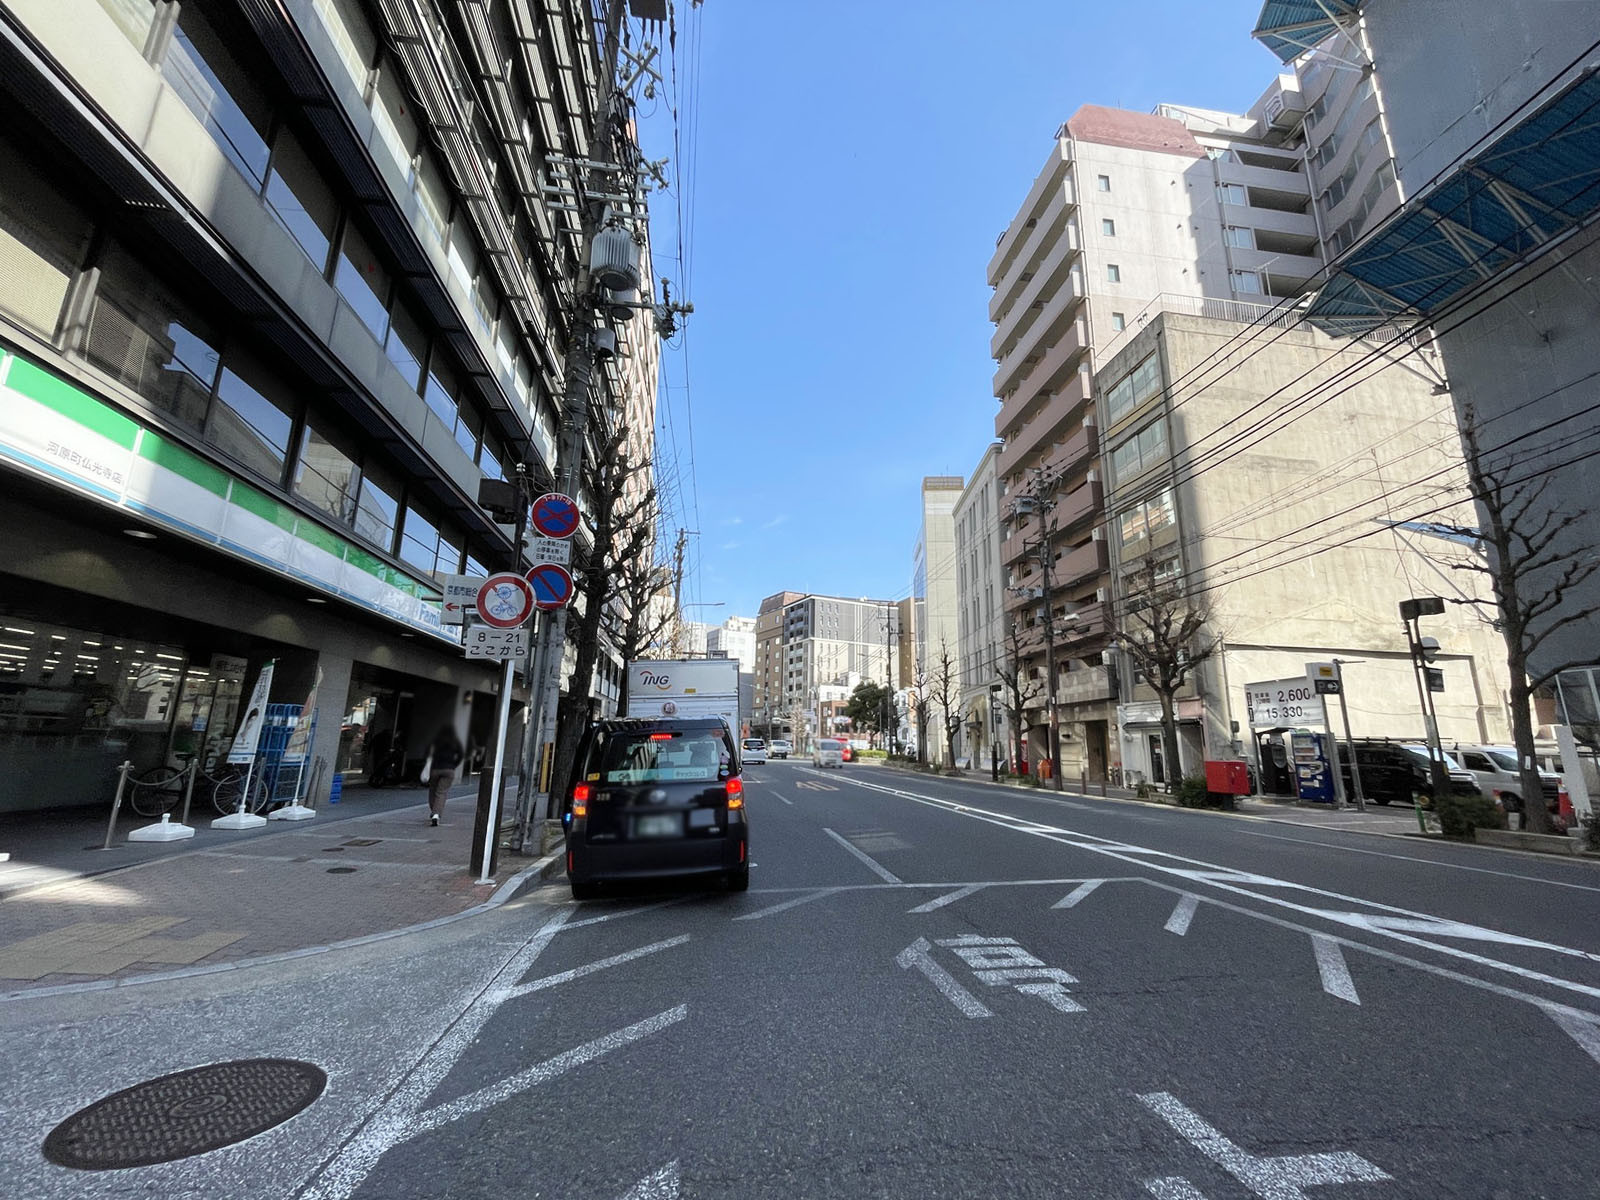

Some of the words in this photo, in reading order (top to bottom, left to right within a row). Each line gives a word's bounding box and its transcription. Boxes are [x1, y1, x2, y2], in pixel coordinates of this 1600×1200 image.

[46, 440, 122, 484] 河原町仏光寺店
[470, 645, 525, 656] ここから
[642, 675, 669, 686] ING
